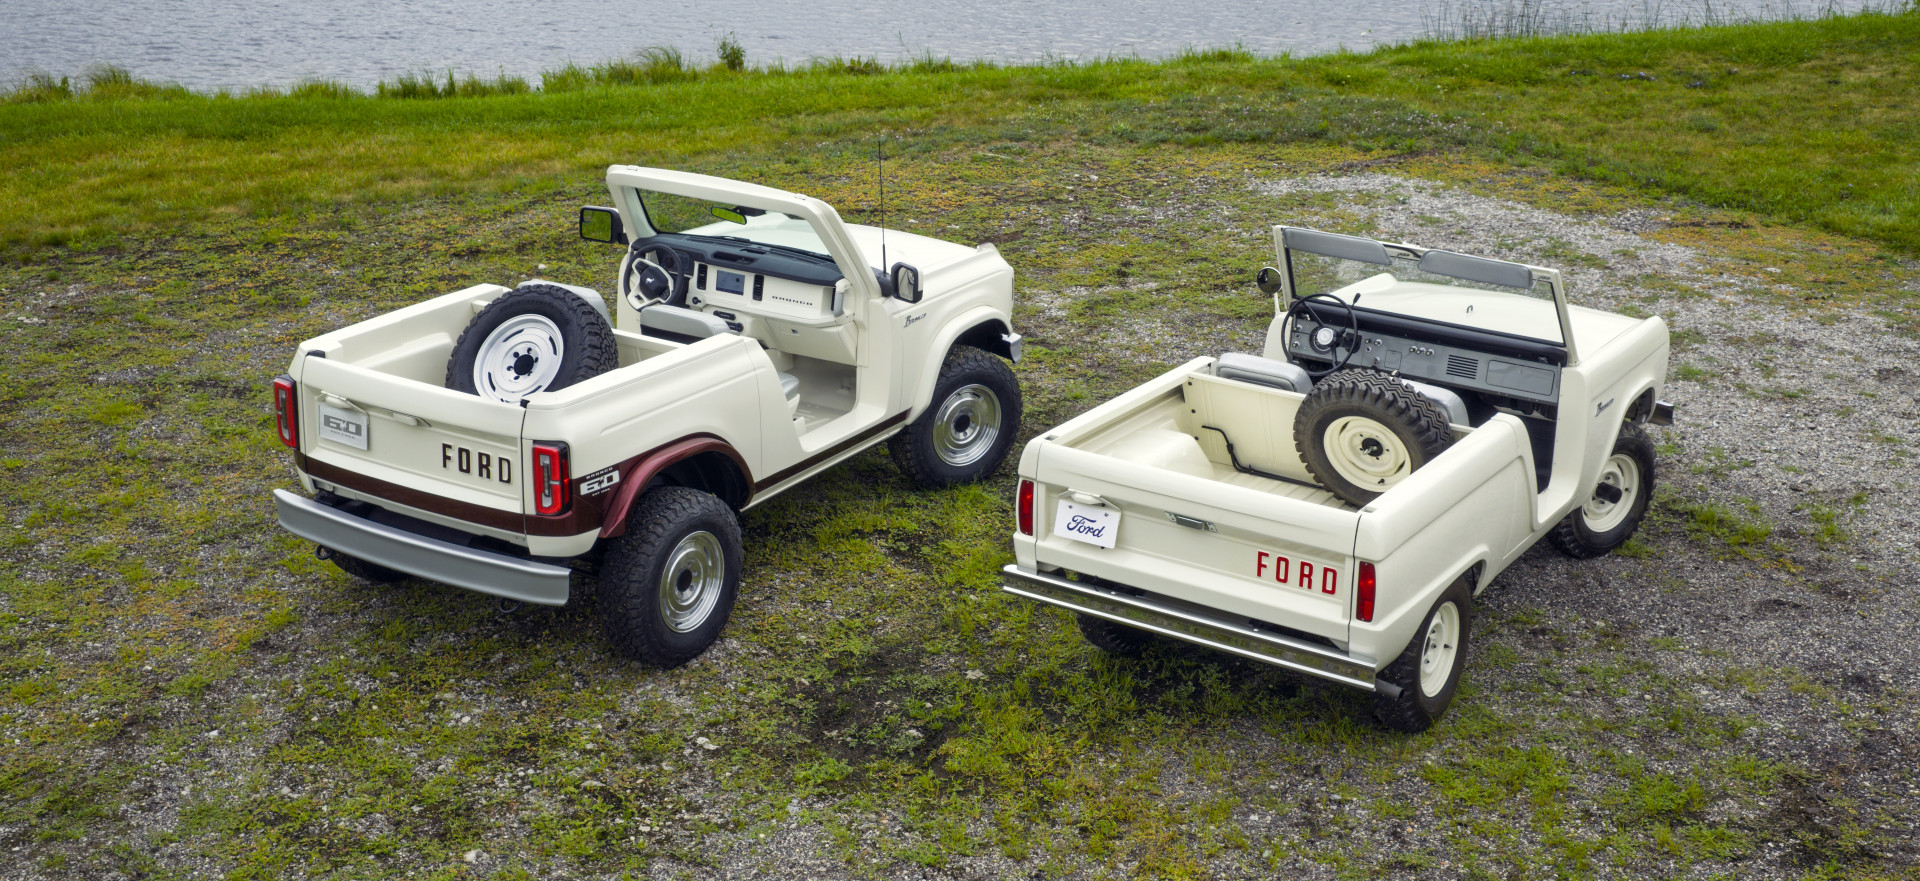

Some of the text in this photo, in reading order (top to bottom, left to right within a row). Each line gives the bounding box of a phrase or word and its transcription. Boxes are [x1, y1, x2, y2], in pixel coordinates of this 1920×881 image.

[442, 443, 512, 484] FORD
[1067, 515, 1105, 538] Ford
[1257, 551, 1338, 595] FORD
